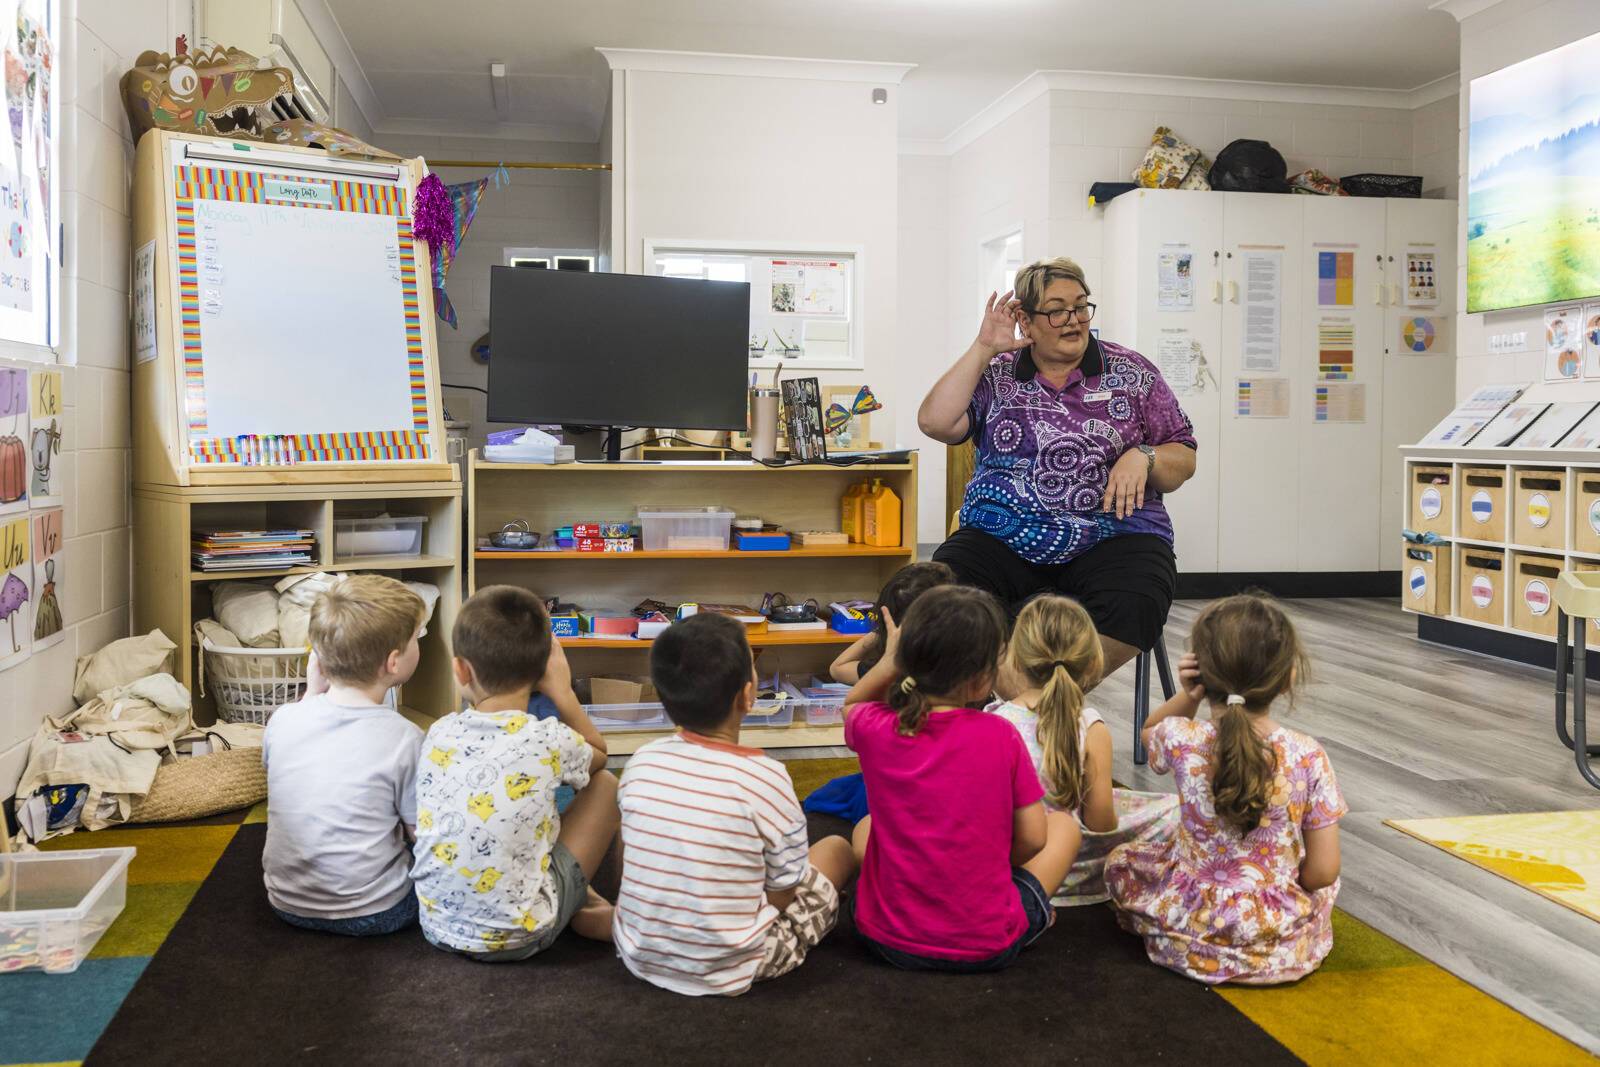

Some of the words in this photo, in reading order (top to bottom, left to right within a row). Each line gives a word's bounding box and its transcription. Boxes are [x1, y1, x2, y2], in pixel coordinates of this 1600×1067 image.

[279, 186, 300, 200] Long
[301, 187, 318, 198] Date
[4, 523, 24, 569] Uu
[41, 513, 57, 556] Vv
